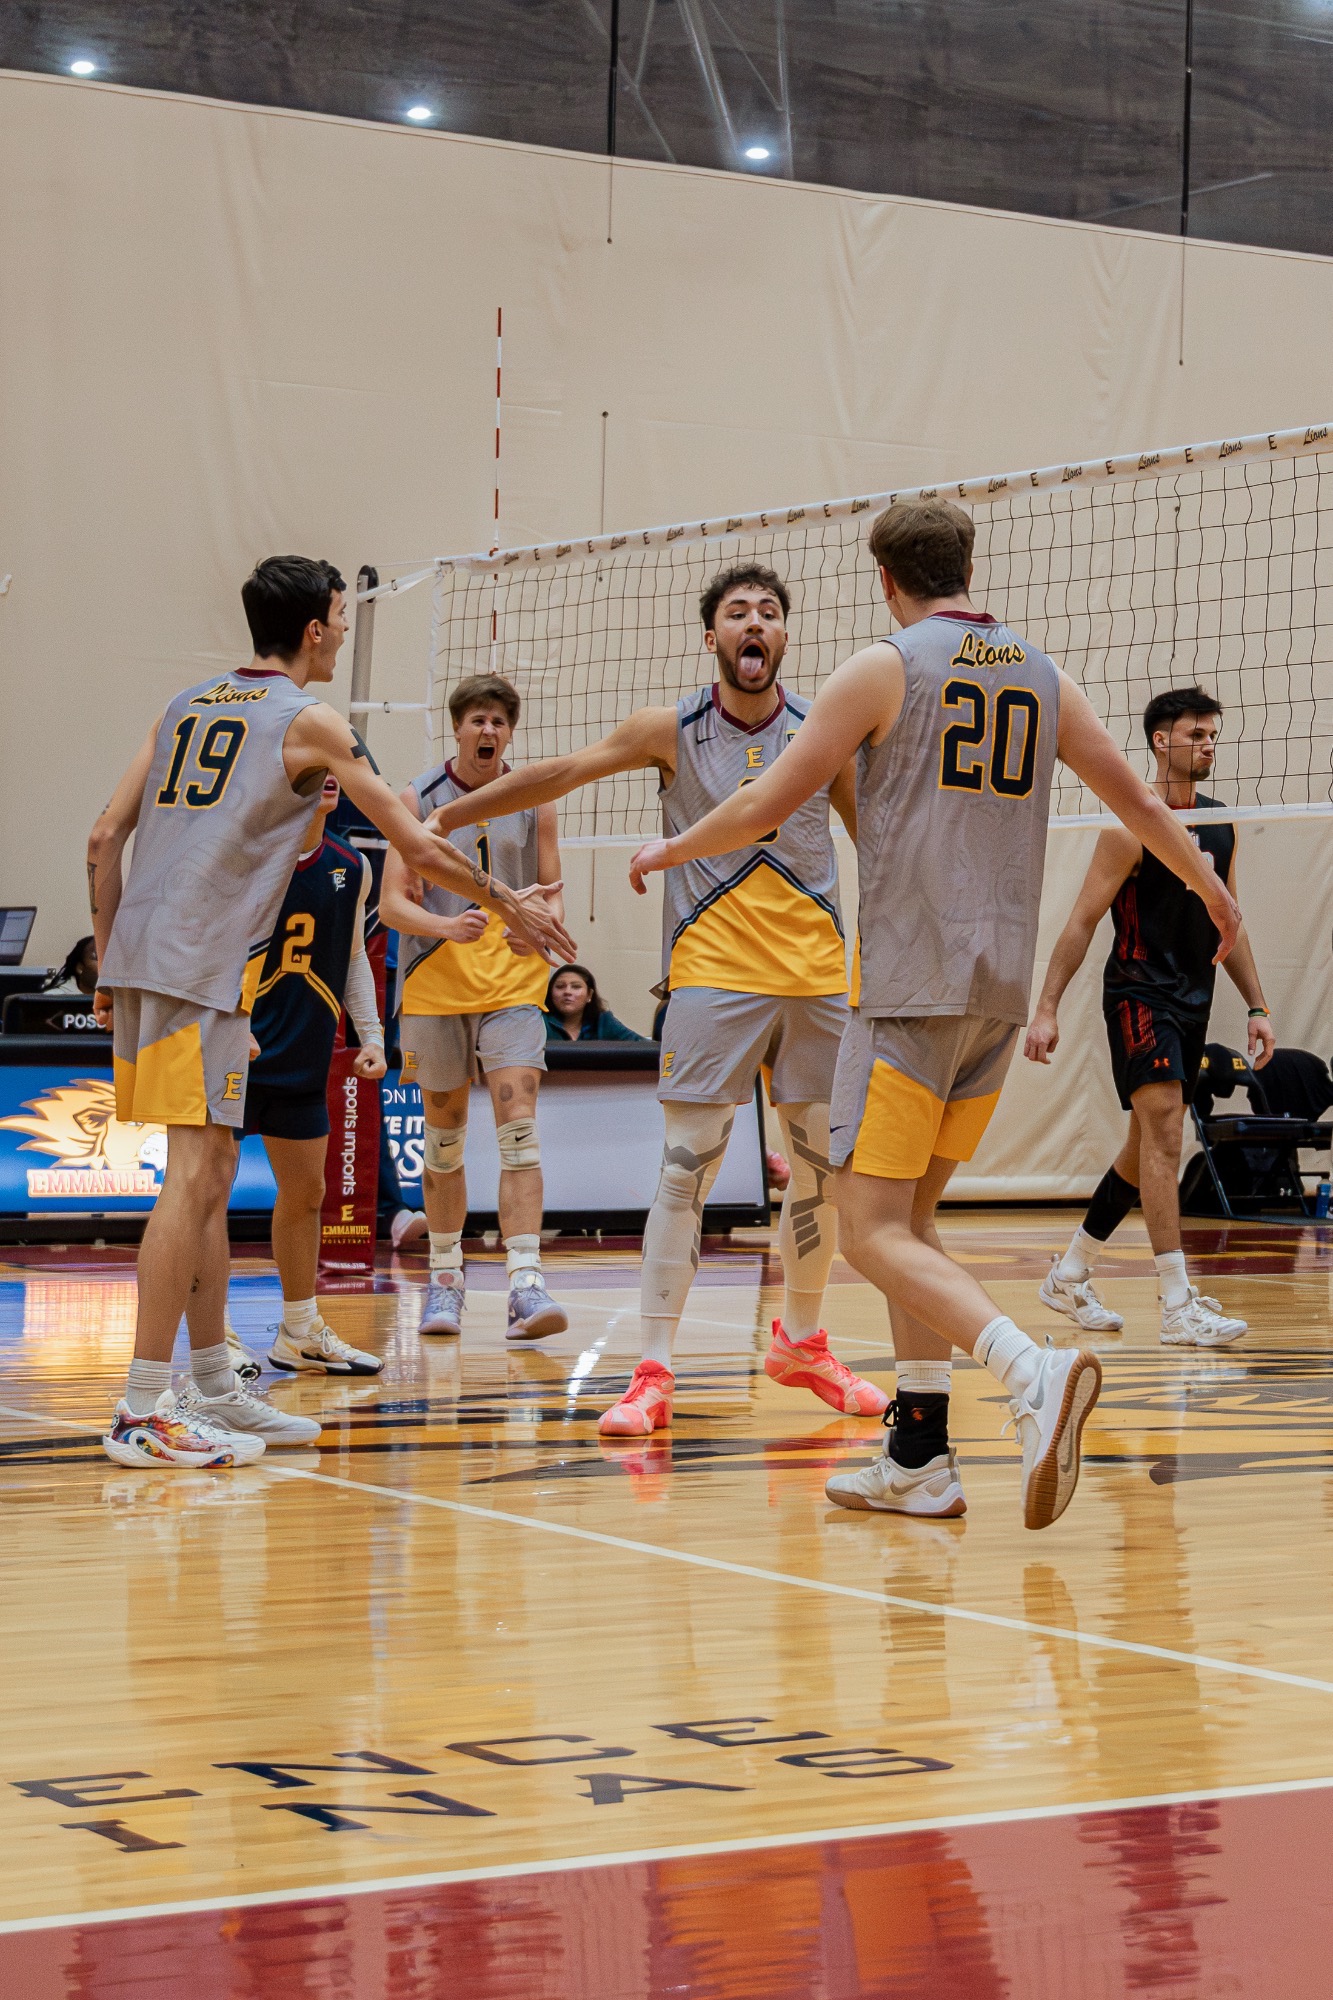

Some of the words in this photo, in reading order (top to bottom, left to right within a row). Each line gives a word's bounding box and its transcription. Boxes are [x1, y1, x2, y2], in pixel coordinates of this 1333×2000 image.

[533, 548, 541, 561] E
[587, 540, 595, 554] E
[609, 536, 627, 550] Lions
[643, 532, 651, 545] E
[666, 526, 685, 542] Lions
[701, 523, 708, 536] E
[725, 518, 743, 533] Lions
[760, 513, 769, 528] E
[786, 508, 806, 524] Lions
[823, 503, 831, 518] E
[851, 499, 870, 514] Lions
[957, 483, 967, 498] E
[987, 477, 1008, 494] Lions
[1029, 472, 1040, 487] E
[1061, 465, 1083, 483] Lions
[1105, 460, 1116, 475] E
[1137, 453, 1161, 472] Lions
[1184, 447, 1195, 464] E
[1218, 440, 1244, 460] Lions
[1267, 434, 1278, 450] E
[1303, 426, 1329, 446] Lions
[951, 632, 1026, 667] Lions
[189, 681, 269, 706] Lions
[938, 677, 1041, 800] 20
[155, 713, 249, 809] 19
[745, 745, 765, 768] E
[475, 833, 492, 877] 1
[281, 912, 316, 974] 2
[404, 1050, 419, 1069] E
[661, 1051, 676, 1077] E
[222, 1072, 243, 1101] E
[343, 1076, 359, 1129] sports
[340, 1131, 357, 1196] imports
[30, 1170, 162, 1195] EMMANUEL
[341, 1204, 355, 1221] E
[322, 1225, 371, 1236] EMMANUEL
